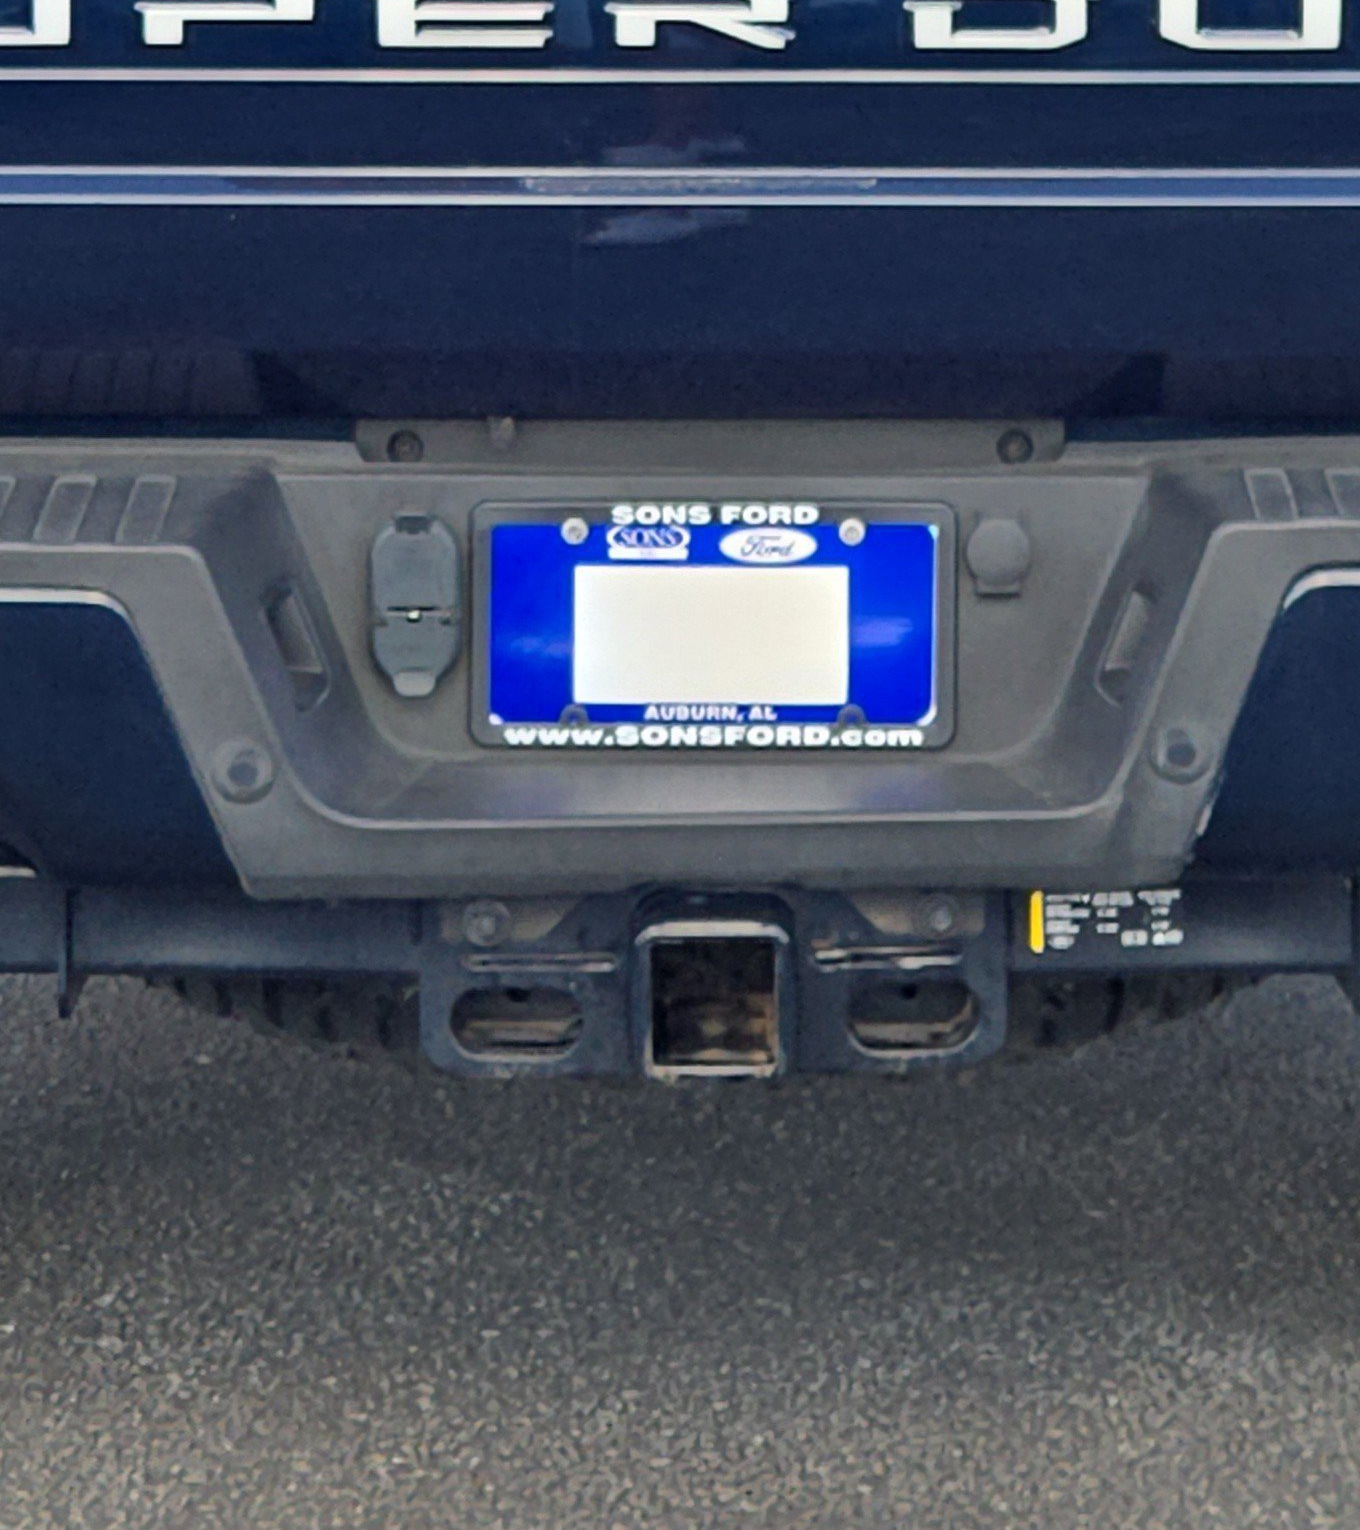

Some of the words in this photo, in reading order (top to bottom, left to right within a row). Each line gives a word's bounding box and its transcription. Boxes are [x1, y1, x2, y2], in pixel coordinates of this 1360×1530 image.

[611, 503, 712, 525] SONS
[720, 503, 819, 525] FORD
[618, 527, 678, 548] SONS
[739, 534, 796, 558] Ford
[643, 705, 745, 723] AUBURN,
[749, 705, 778, 722] AL
[503, 724, 924, 748] www.SONSFORD.com
